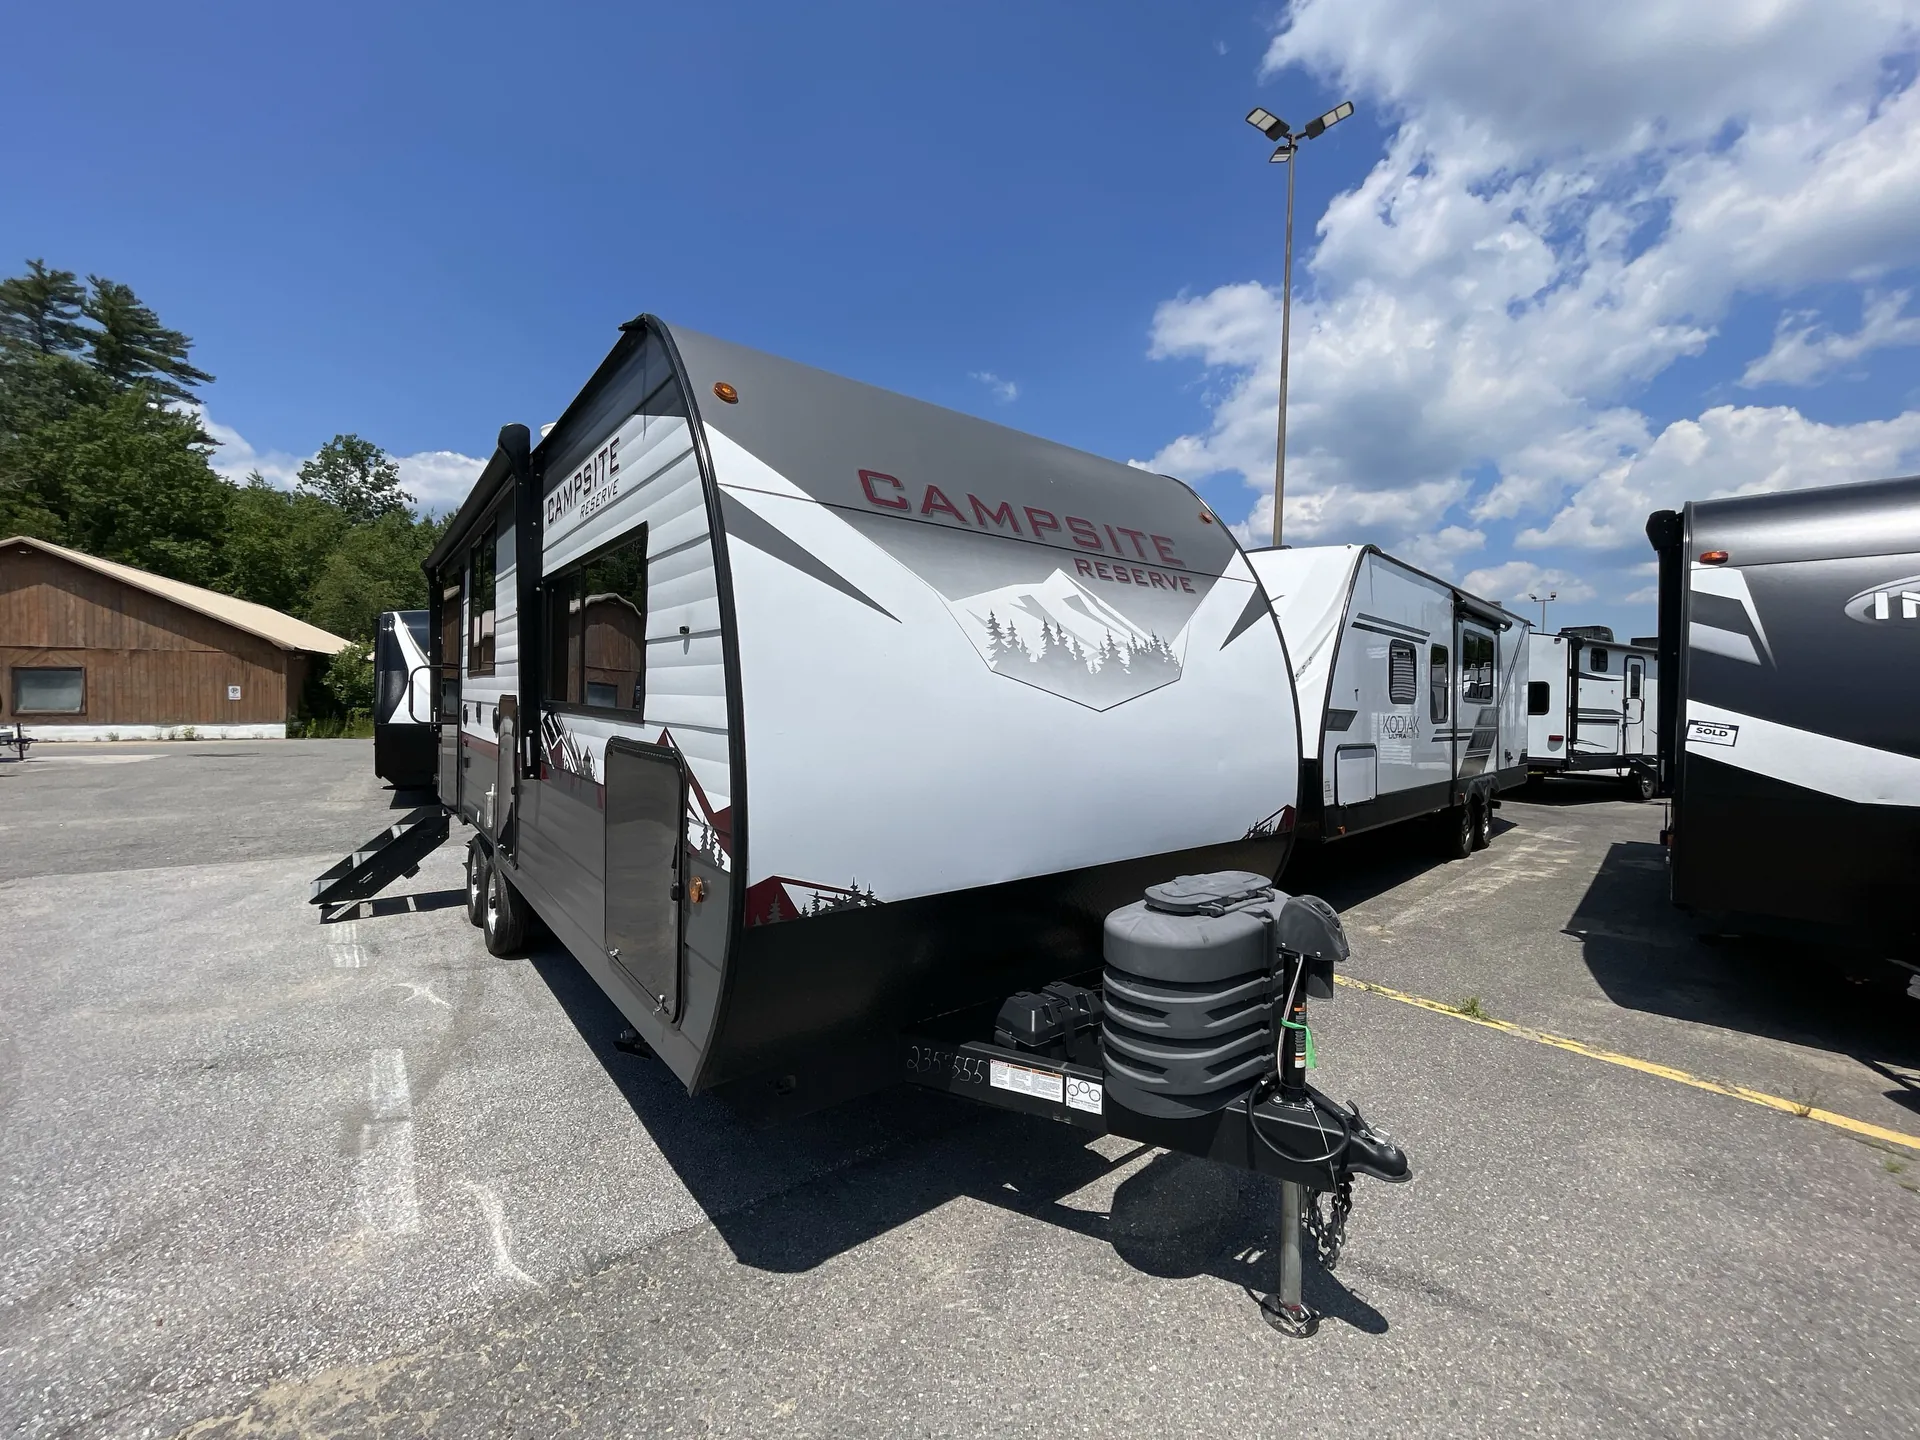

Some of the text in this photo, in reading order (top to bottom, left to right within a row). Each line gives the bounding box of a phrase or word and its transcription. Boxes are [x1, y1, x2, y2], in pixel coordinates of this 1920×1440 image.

[547, 437, 620, 525] CAMPSITE
[580, 478, 620, 519] RESERVE
[858, 469, 1187, 567] CAMPSITE
[1073, 557, 1197, 594] RESERVE
[1382, 715, 1420, 734] KODIAK
[1695, 727, 1728, 737] SOLD
